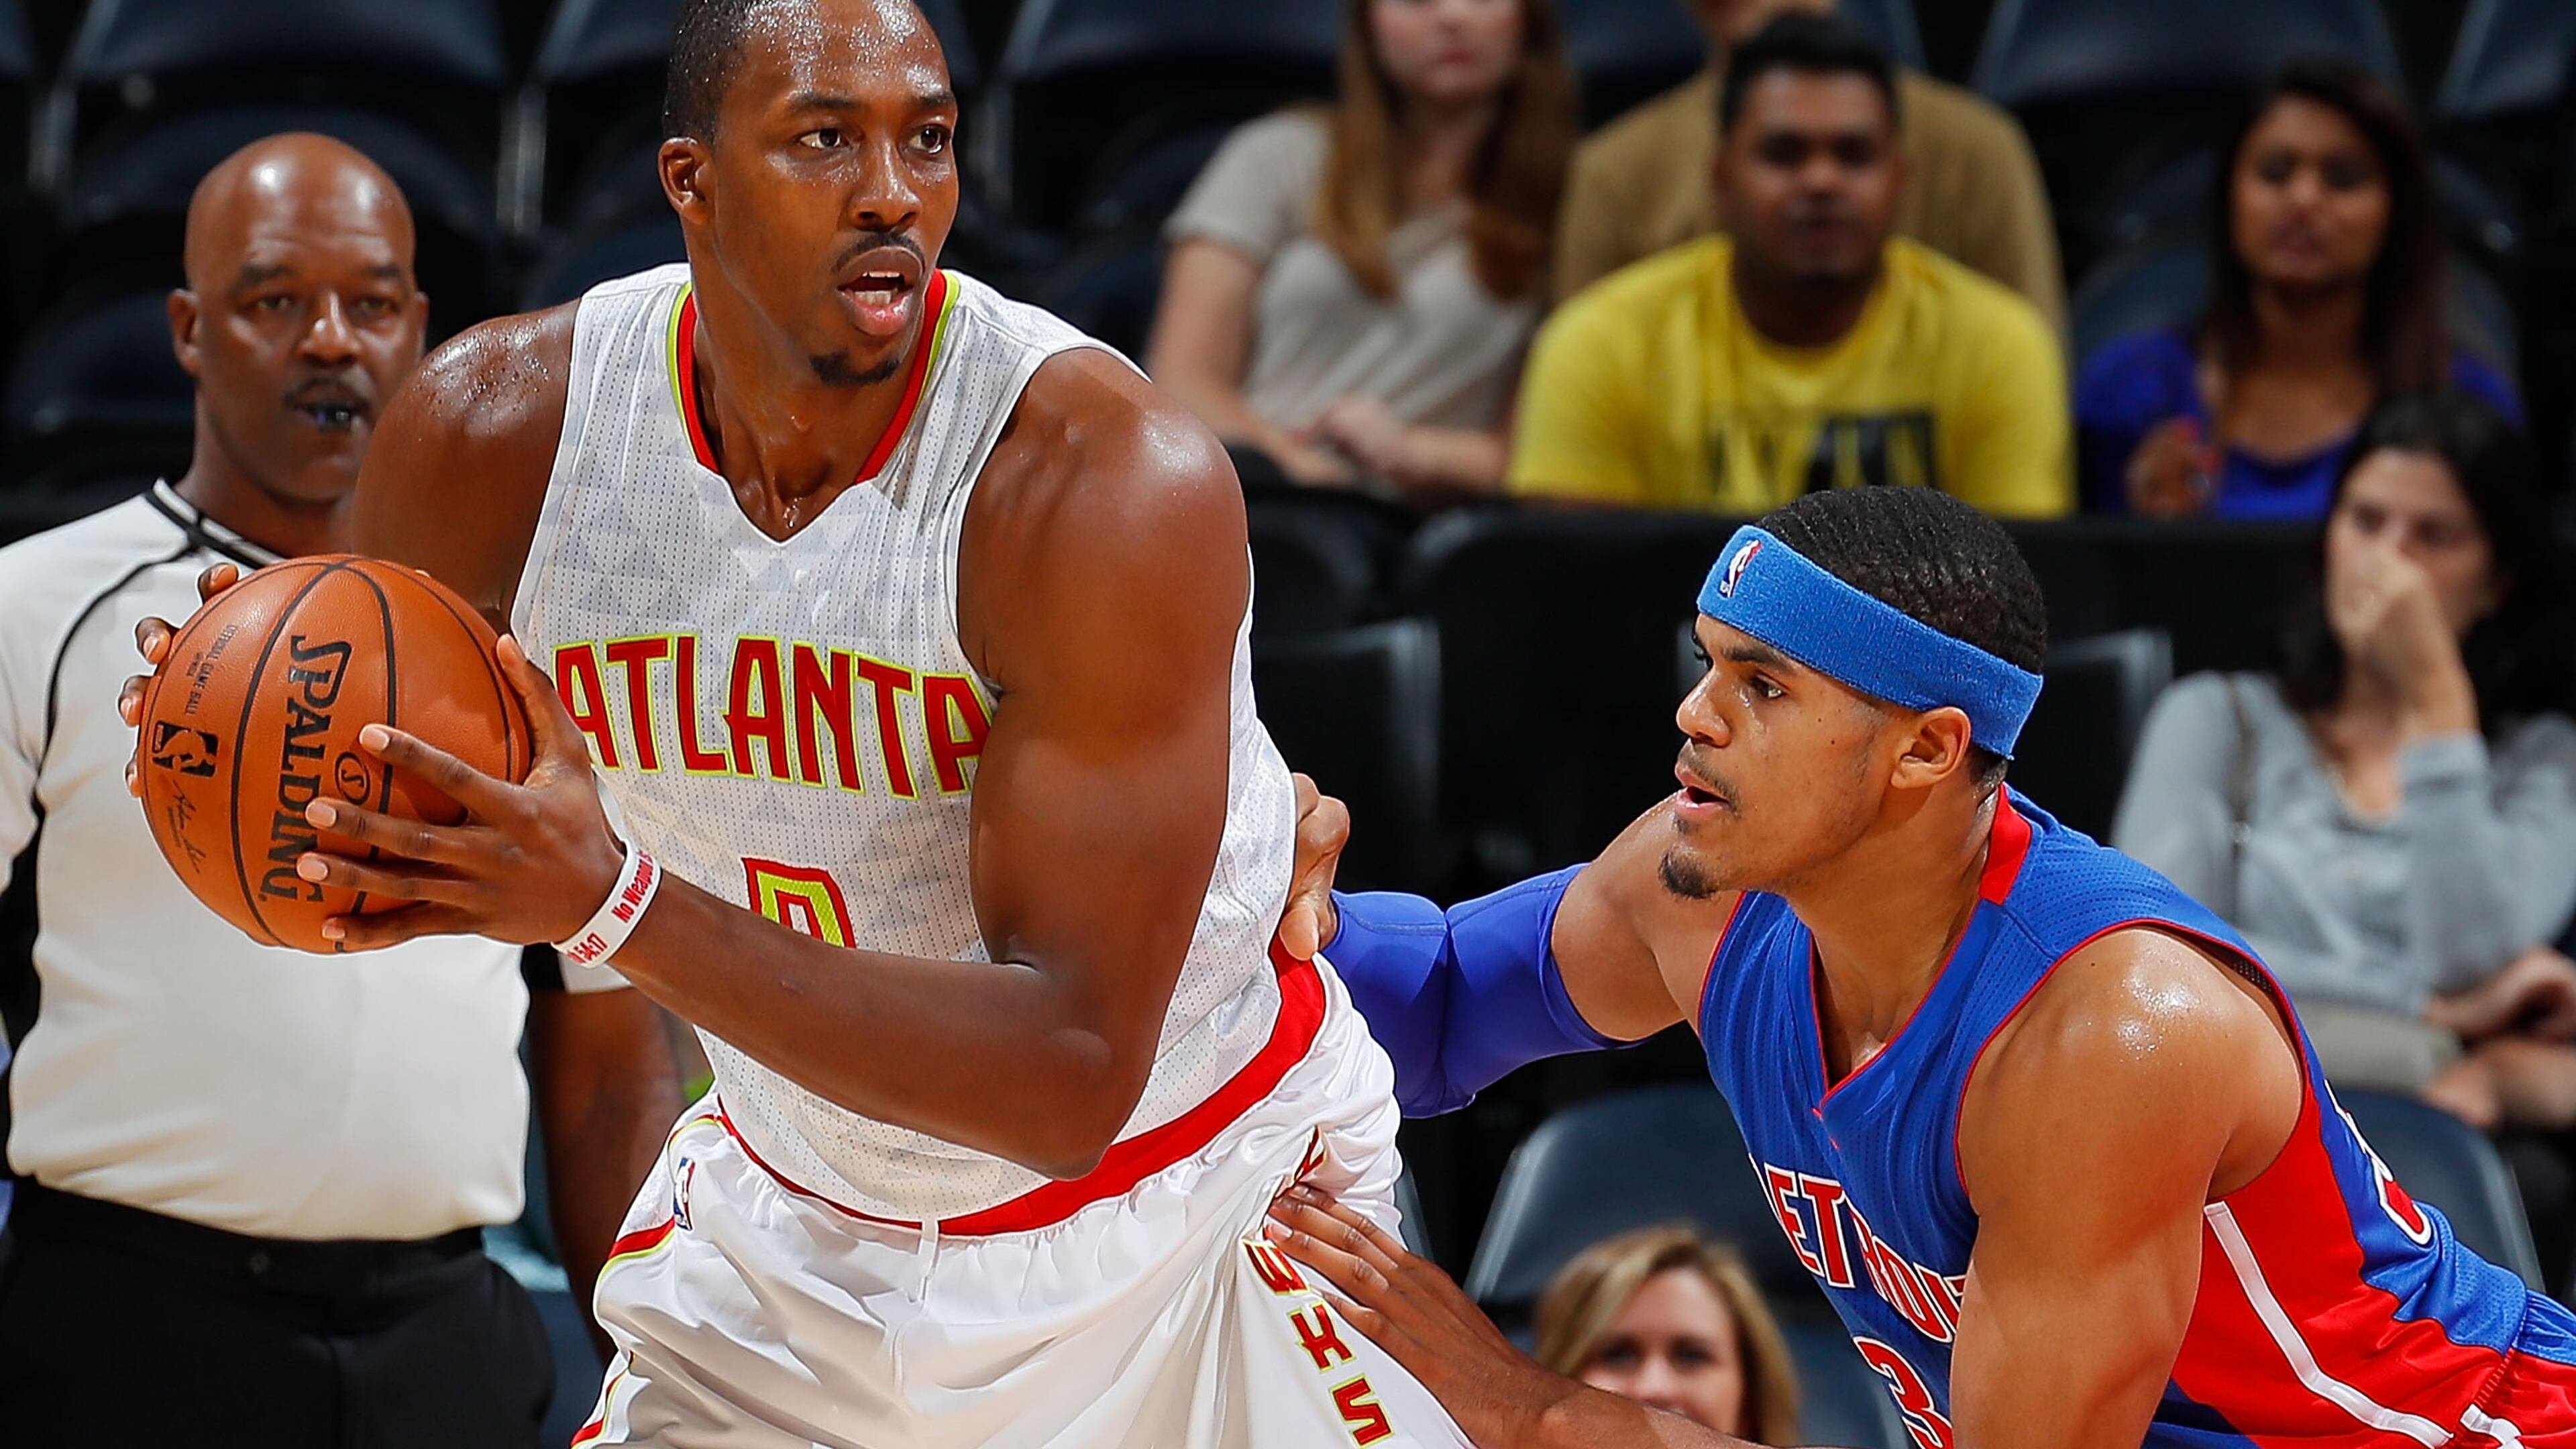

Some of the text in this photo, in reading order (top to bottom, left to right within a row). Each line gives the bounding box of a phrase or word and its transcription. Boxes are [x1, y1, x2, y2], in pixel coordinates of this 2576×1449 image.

[184, 691, 201, 715] BALL
[194, 662, 214, 690] GAME
[552, 633, 996, 800] ATLANTA
[259, 633, 353, 903] SPALDING
[611, 902, 635, 924] No
[1749, 1152, 1968, 1343] ETROI
